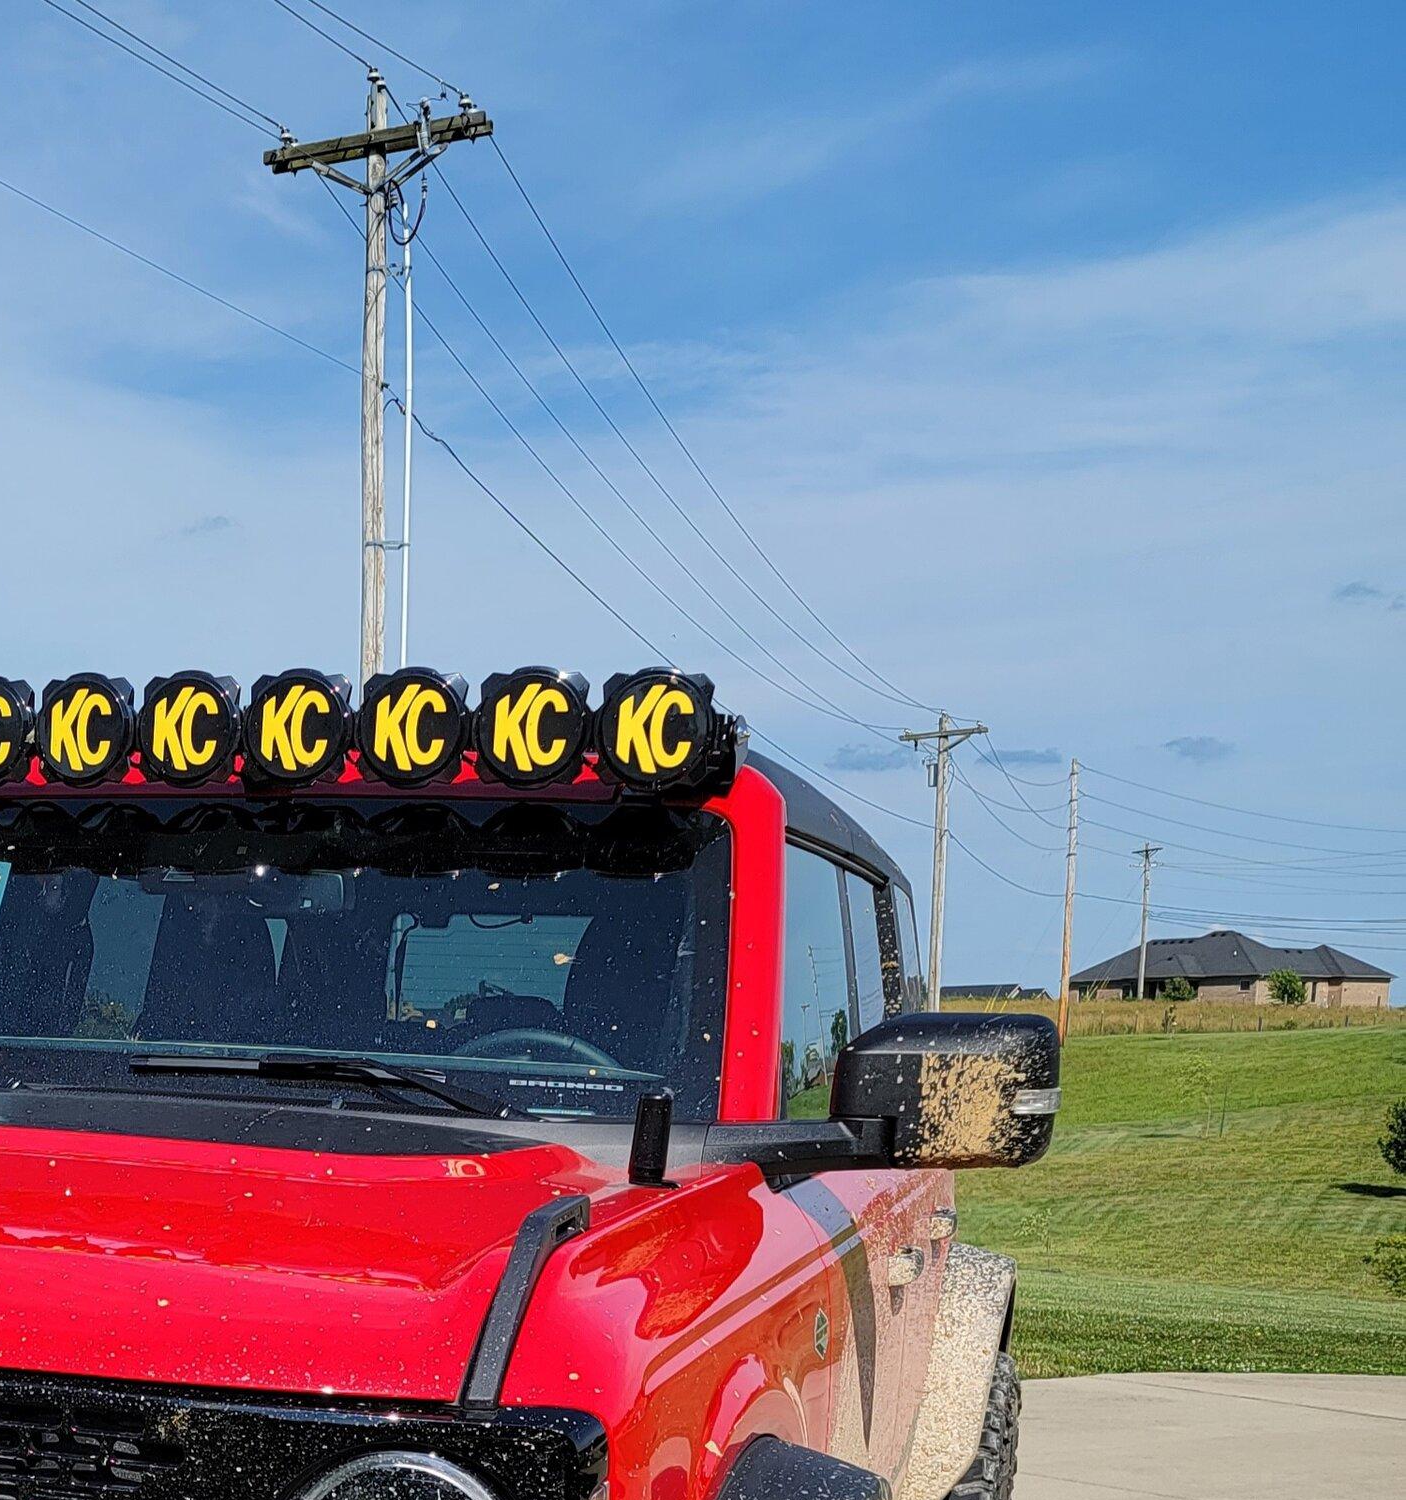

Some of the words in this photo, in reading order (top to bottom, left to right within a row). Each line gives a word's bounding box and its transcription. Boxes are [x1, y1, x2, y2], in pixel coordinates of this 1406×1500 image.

[51, 689, 112, 771] KC
[153, 687, 219, 771] KC
[262, 685, 330, 771] KC
[374, 684, 447, 771] KC
[493, 684, 569, 772] KC
[616, 685, 695, 774] KC
